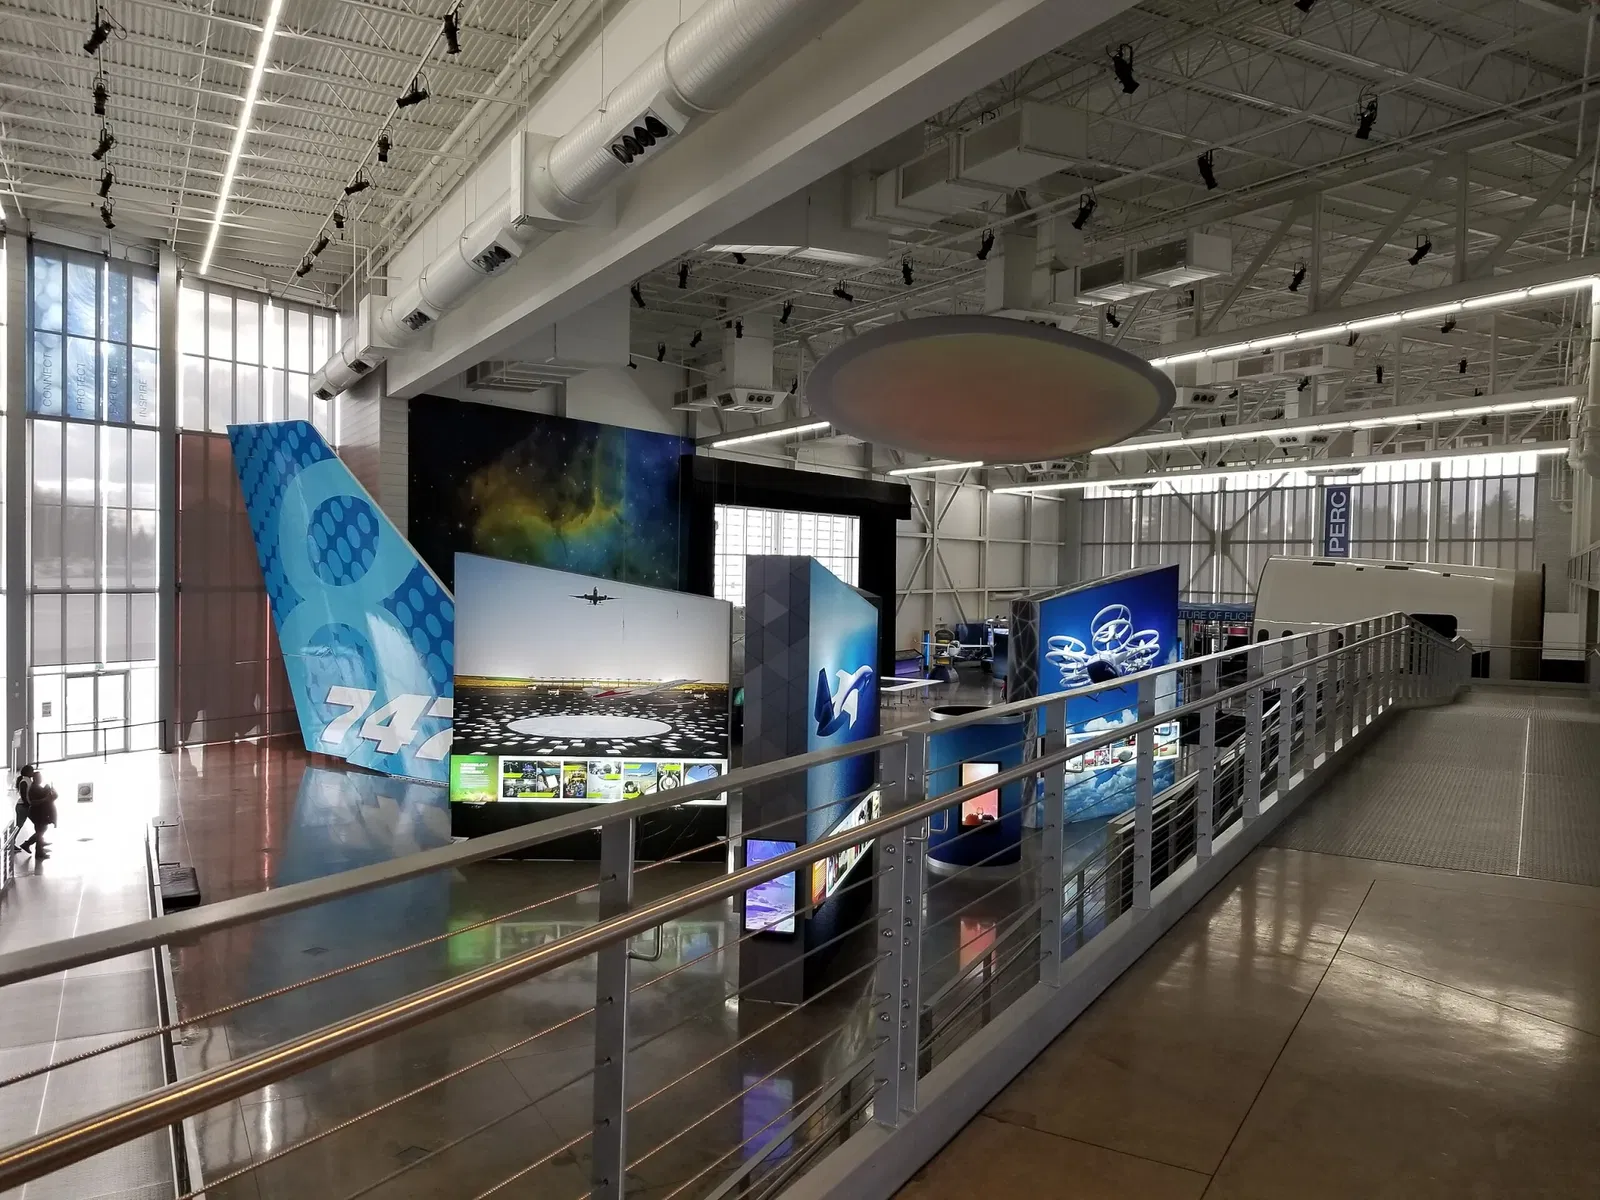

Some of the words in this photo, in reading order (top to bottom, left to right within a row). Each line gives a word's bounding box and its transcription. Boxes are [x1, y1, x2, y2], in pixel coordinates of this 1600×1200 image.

[43, 353, 53, 407] CONNECT
[77, 362, 86, 411] PROTECT
[139, 379, 149, 417] INSPIRE
[1177, 610, 1207, 620] TURE
[1208, 611, 1222, 620] OF
[1224, 612, 1253, 621] FLIGH
[320, 685, 453, 761] 747
